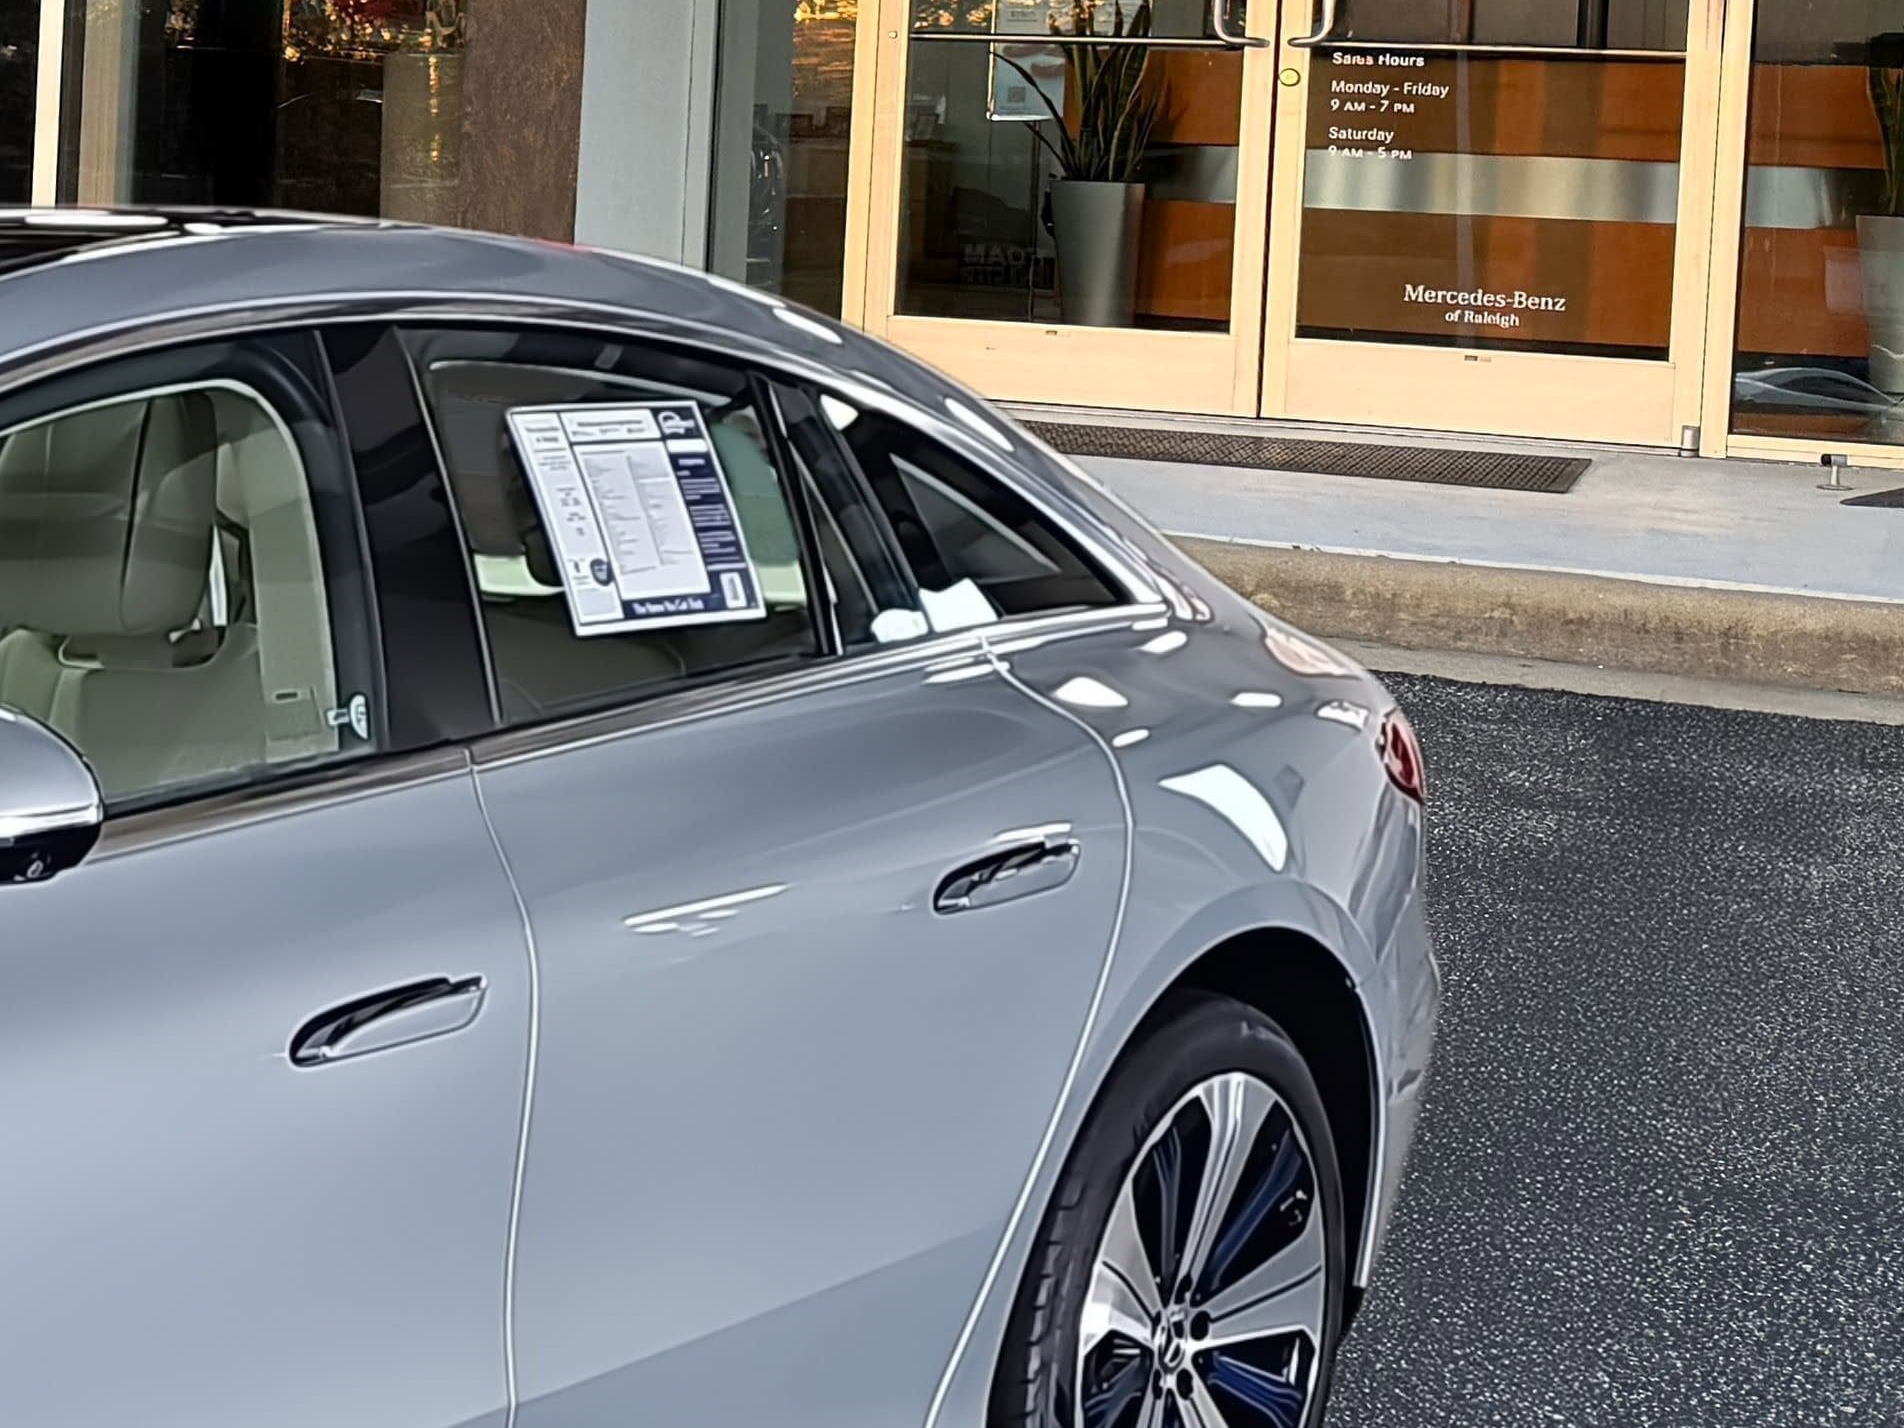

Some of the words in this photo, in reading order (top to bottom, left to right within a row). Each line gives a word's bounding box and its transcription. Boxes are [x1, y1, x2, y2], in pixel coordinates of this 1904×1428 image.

[1378, 53, 1425, 67] Hours
[1331, 80, 1390, 97] Monday
[1403, 82, 1449, 99] Friday
[1330, 99, 1340, 111] 9
[1343, 102, 1366, 112] AM
[1380, 100, 1389, 112] 7
[1393, 103, 1415, 113] PM
[1328, 126, 1394, 144] Saturday
[1341, 148, 1364, 158] AM
[1378, 146, 1387, 158] 5
[1391, 149, 1412, 160] PM
[1403, 284, 1566, 312] Mercedes-Benz
[1445, 309, 1461, 322] of
[1464, 310, 1520, 328] Raleigh
